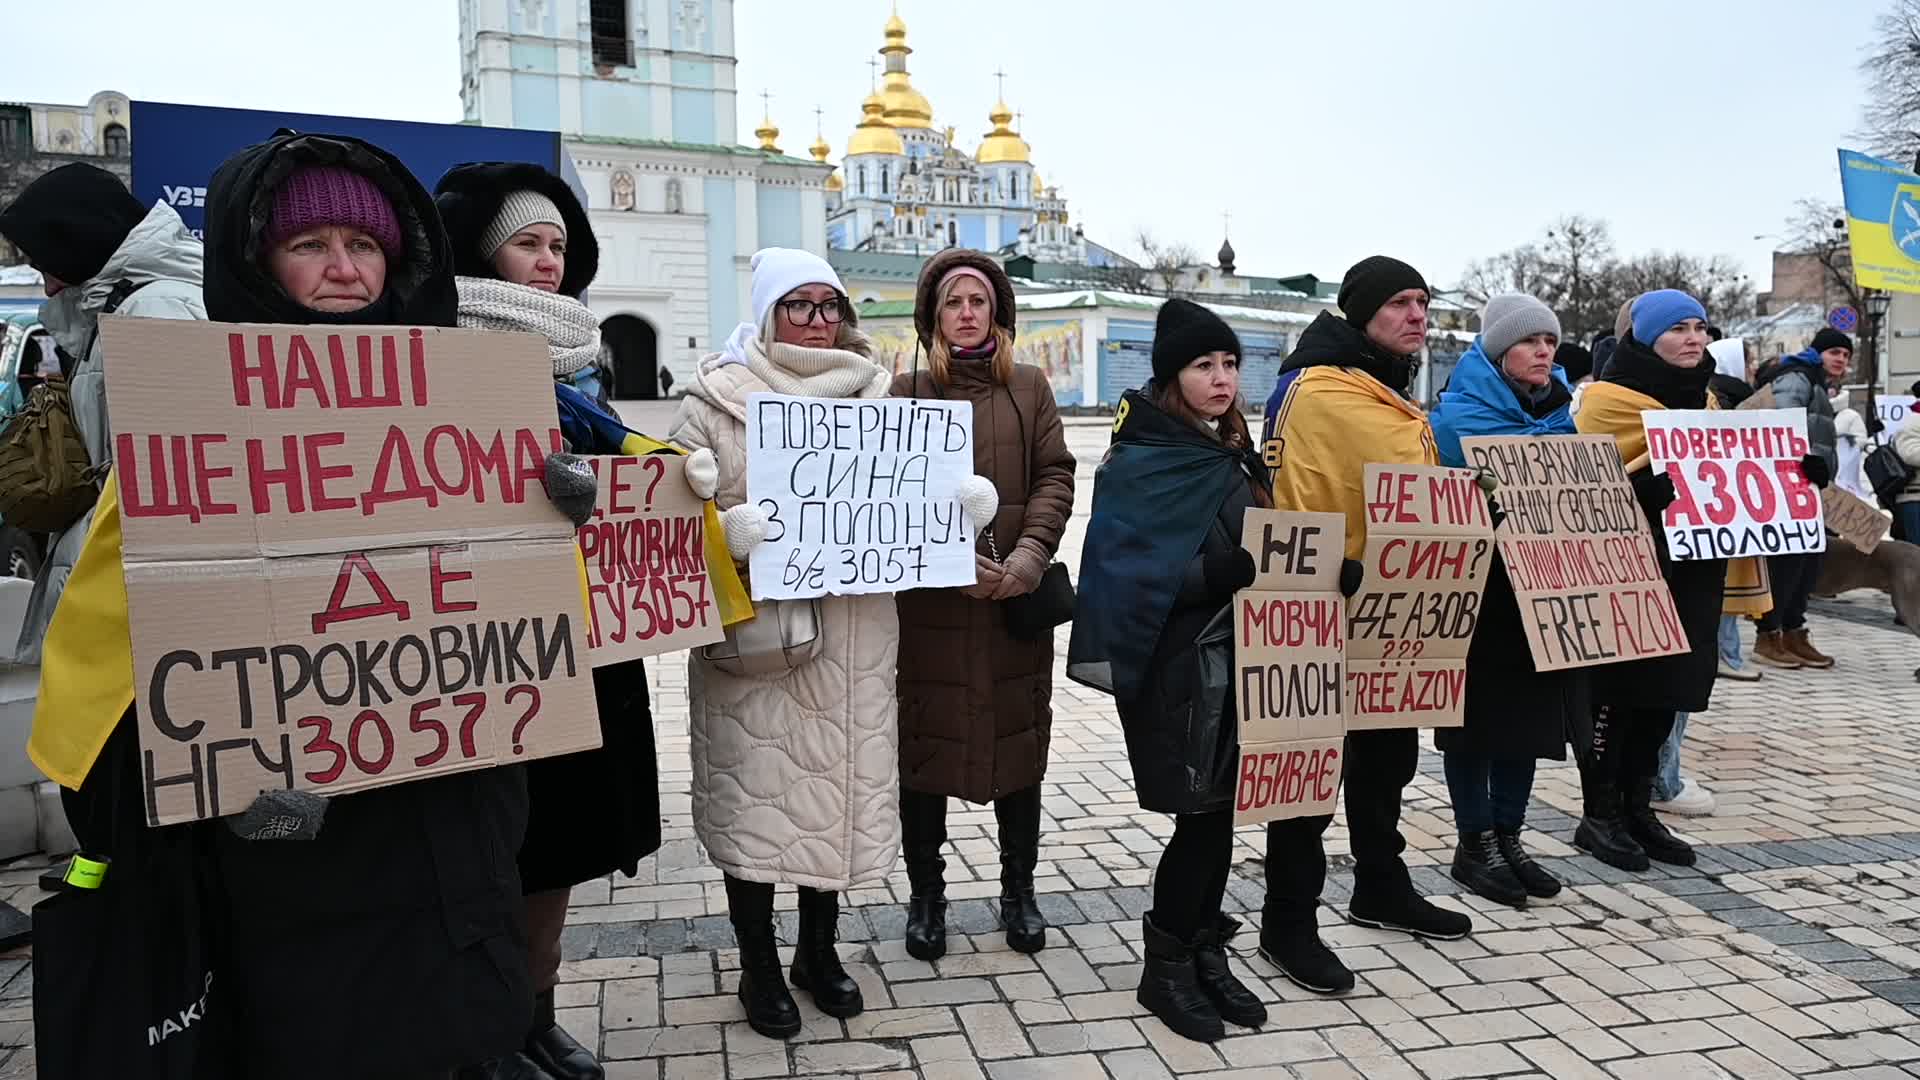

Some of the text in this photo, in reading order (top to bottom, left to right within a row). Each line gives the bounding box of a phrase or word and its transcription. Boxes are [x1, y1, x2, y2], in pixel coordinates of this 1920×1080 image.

[227, 328, 428, 410] НАШІ
[758, 399, 968, 453] ПОВЕРНІТЬ
[1646, 425, 1809, 460] ПОВЕРНІТЬ
[115, 432, 239, 523] ЩЕ
[245, 431, 358, 516] НЕ
[789, 450, 929, 499] СИНА
[1471, 439, 1627, 488] ВОНИ ЗАХИЩАЛИ
[1367, 469, 1488, 528] ДЕ МІЙ
[1499, 486, 1640, 537] НАШУ СВОБОДУ
[1663, 458, 1819, 527] АЗОВ
[758, 498, 968, 546] З ПОЛОНУ!
[1259, 522, 1322, 576] НЕ
[574, 515, 707, 585] РОКОВИКИ
[839, 544, 929, 585] 3057
[1378, 537, 1490, 581] СИН?
[1502, 540, 1518, 592] А
[311, 543, 479, 634] ДЕ
[1347, 590, 1480, 640] ДЕ АЗОВ
[1242, 598, 1344, 654] МОВЧИ,
[1531, 588, 1685, 665] FREE AZOV
[147, 612, 578, 743] СТРОКОВИКИ
[1241, 661, 1342, 722] ПОЛОН
[1398, 668, 1466, 713] AZOV
[1235, 747, 1339, 812] ВБИВАЄ
